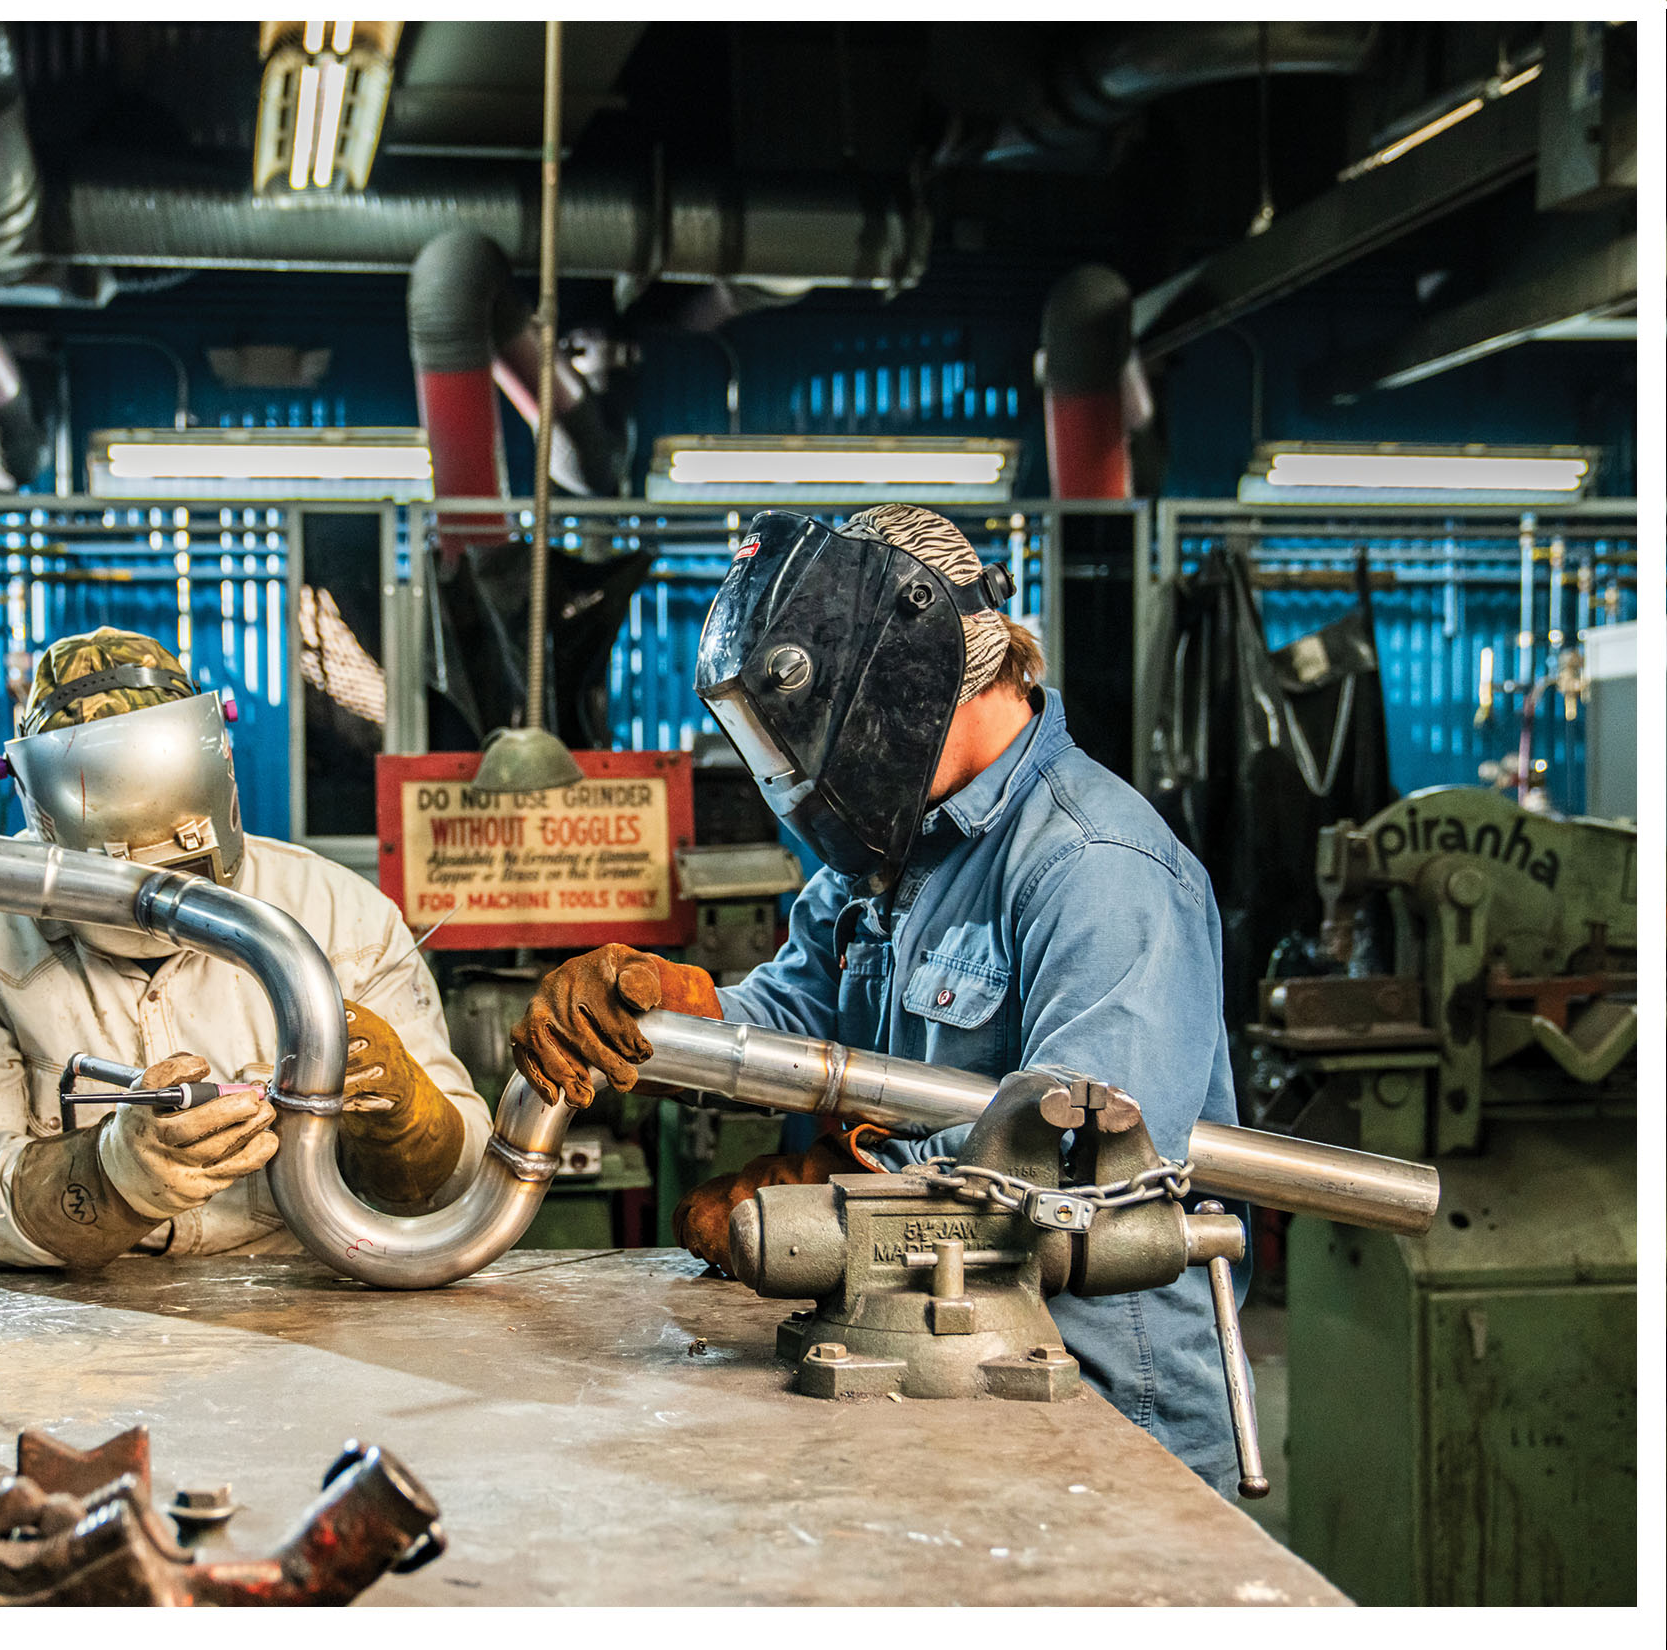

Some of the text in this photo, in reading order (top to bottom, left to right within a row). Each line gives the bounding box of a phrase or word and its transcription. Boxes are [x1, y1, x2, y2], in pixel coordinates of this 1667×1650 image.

[420, 784, 652, 811] DO NOT USE GRINDER
[430, 815, 641, 847] WITHOUT GOGGLES
[1375, 806, 1559, 890] piranha
[419, 889, 658, 912] FOR MACHINE TOOLS ONLY
[937, 1221, 980, 1240] JAW
